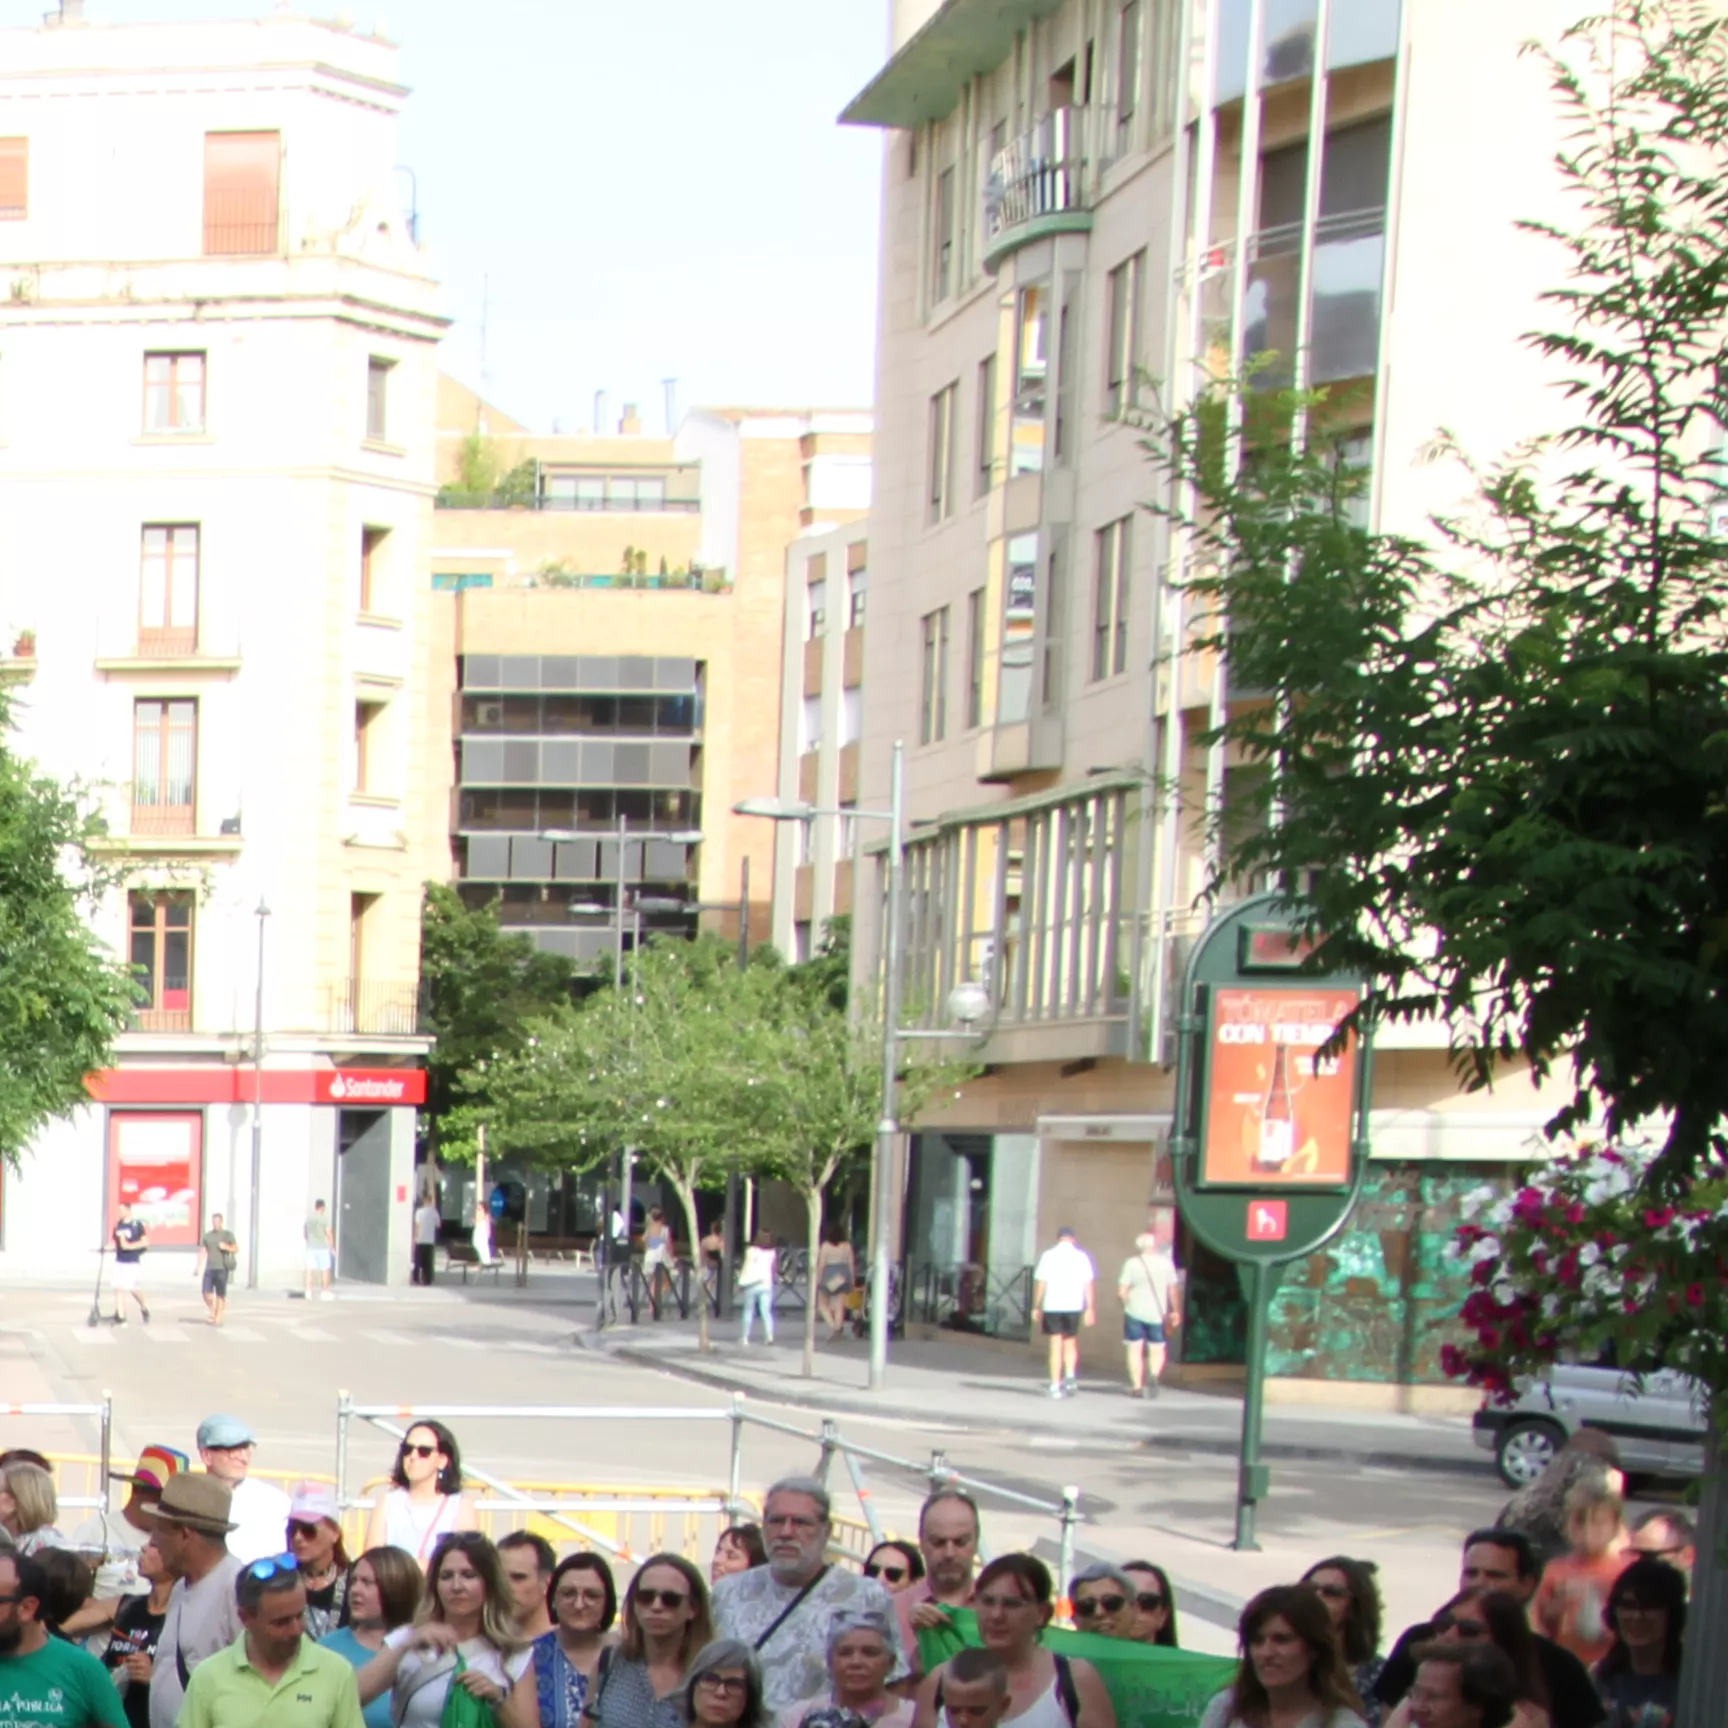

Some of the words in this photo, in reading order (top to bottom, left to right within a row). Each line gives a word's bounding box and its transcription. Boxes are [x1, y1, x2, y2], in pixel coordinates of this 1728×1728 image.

[1219, 1024, 1265, 1044] CON
[1270, 1023, 1335, 1045] TIEMP
[345, 1077, 404, 1098] Santander
